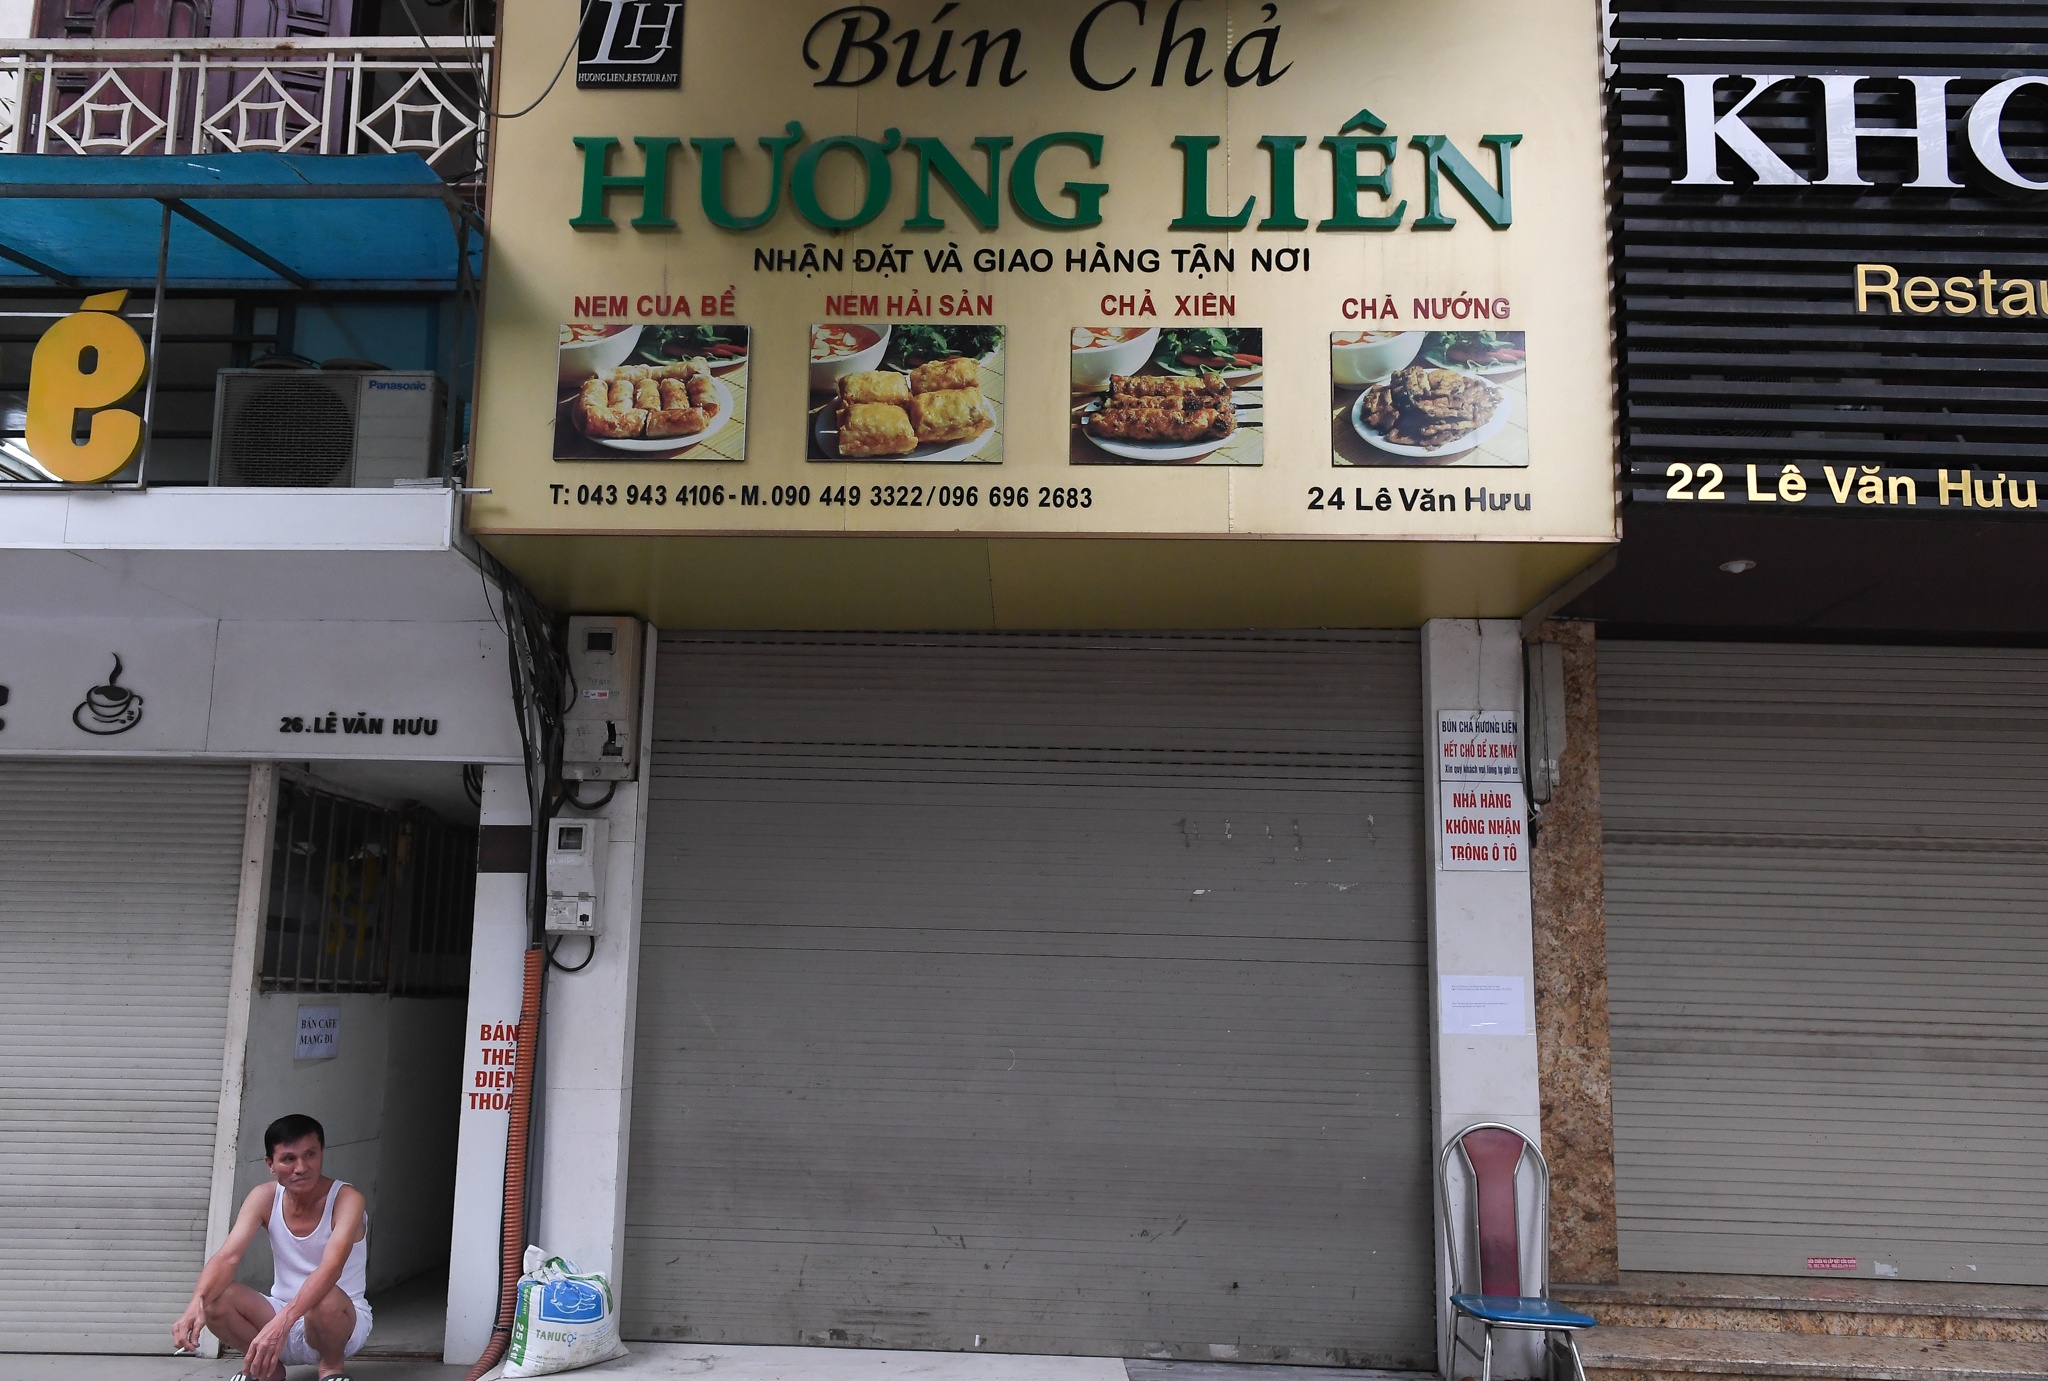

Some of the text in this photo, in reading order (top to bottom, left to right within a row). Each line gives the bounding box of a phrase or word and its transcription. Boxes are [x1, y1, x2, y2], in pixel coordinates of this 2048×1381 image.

[803, 0, 1294, 92] Bún Chả
[569, 109, 1523, 230] HƯƠNG LIÊN
[754, 242, 1311, 279] NHẬN ĐẶT VÀ GIAO HÀNG TẬN NƠI
[574, 285, 736, 317] NEM CUA BỂ
[1854, 264, 2048, 315] Resta
[825, 290, 994, 317] NEM HẢI SẢN
[1100, 290, 1236, 317] CHẢ XIÊN
[1413, 291, 1511, 320] NƯỚNG
[25, 289, 149, 483] é
[369, 380, 427, 390] Panasonic
[550, 484, 570, 505] T:
[577, 484, 618, 506] 043
[626, 484, 668, 506] 943
[819, 485, 861, 507] 449
[988, 486, 1030, 508] 696
[1038, 486, 1093, 509] 2683
[1666, 463, 2038, 509] 22 Lê Văn Hưu
[1307, 486, 1532, 512] 24 Lê Văn Hưu
[342, 711, 384, 735] VĂN
[392, 716, 438, 736] HƯU
[1442, 718, 1457, 733] BÚN
[1475, 720, 1500, 734] HƯƠNG
[1501, 719, 1518, 734] LIÊN
[1443, 740, 1458, 758] HẾT
[1477, 739, 1487, 758] ĐỂ
[1489, 743, 1499, 759] XE
[1500, 742, 1518, 759] MÁY
[1480, 789, 1512, 809] HÀNG
[1445, 816, 1521, 839] KHÔNG NHẬN
[1450, 843, 1517, 861] TRÔNG Ô TÔ
[300, 1034, 323, 1045] MANG
[480, 1020, 519, 1042] BÁN
[481, 1041, 516, 1065] THẺ
